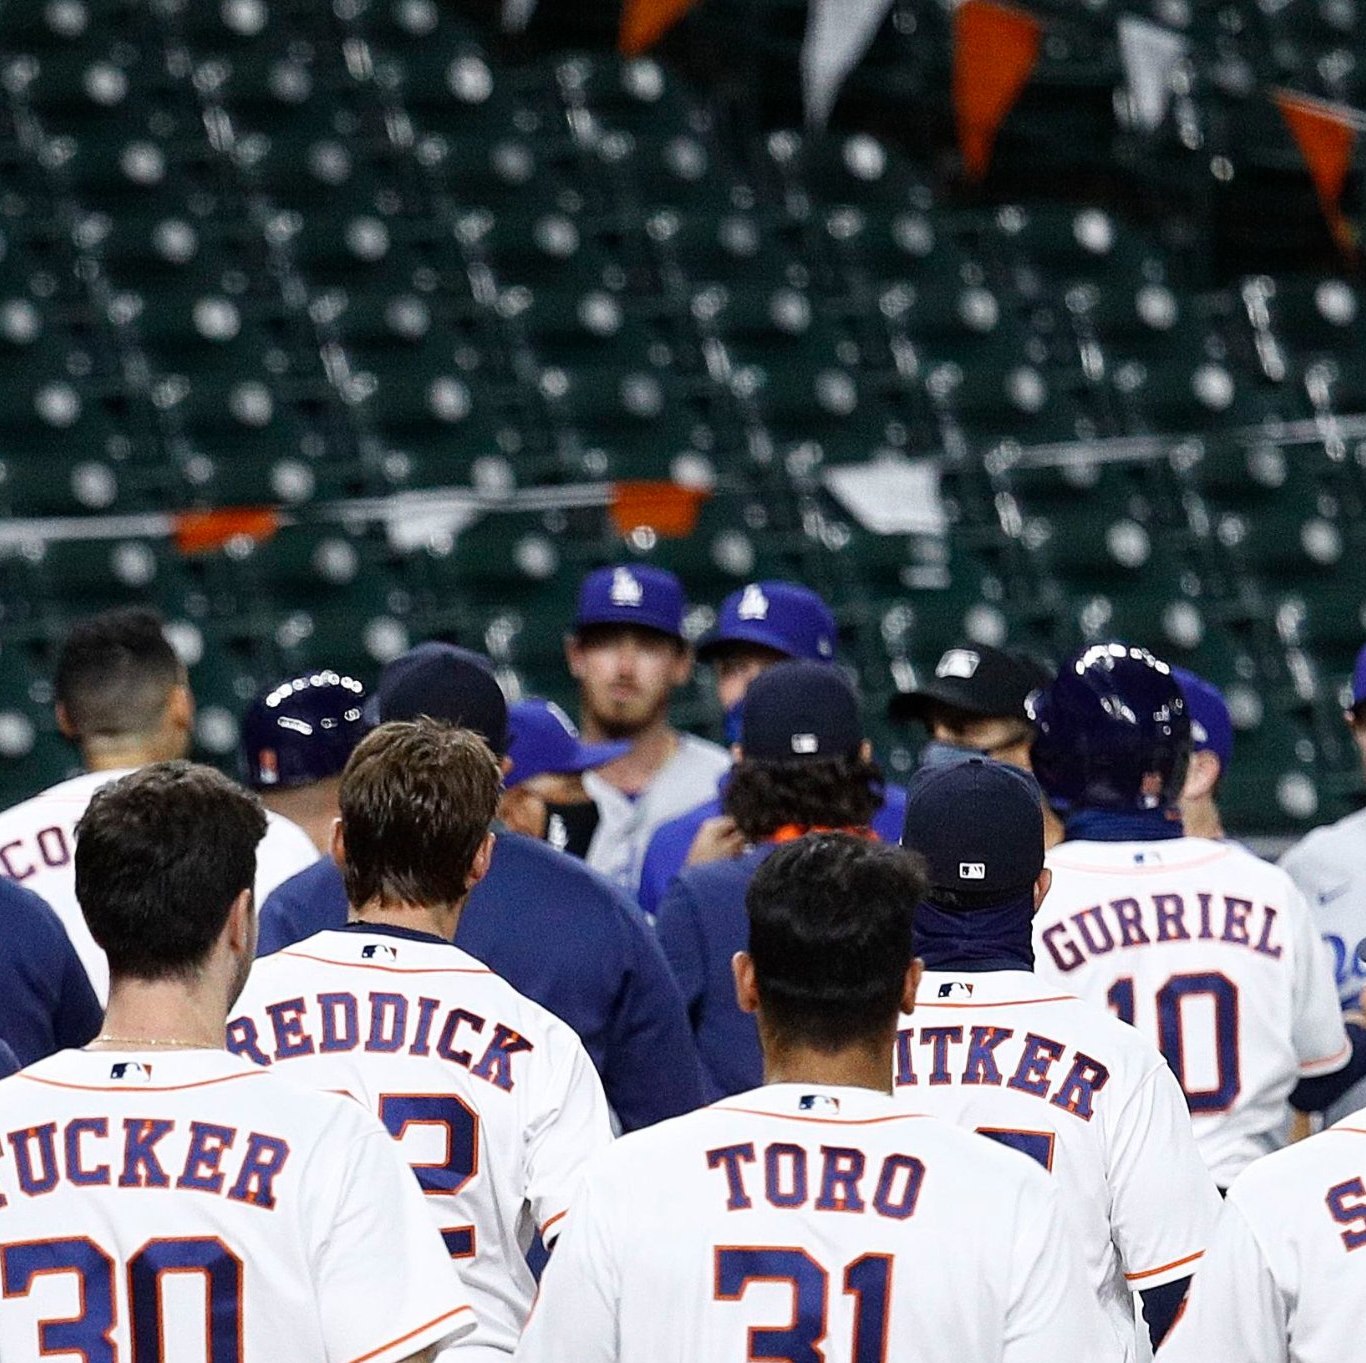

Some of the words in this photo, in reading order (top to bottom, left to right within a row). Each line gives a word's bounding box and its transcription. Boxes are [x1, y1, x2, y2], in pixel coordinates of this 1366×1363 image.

[1041, 893, 1284, 973] GURRIEL
[225, 992, 534, 1093] REDDICK
[706, 1143, 926, 1221] TORO
